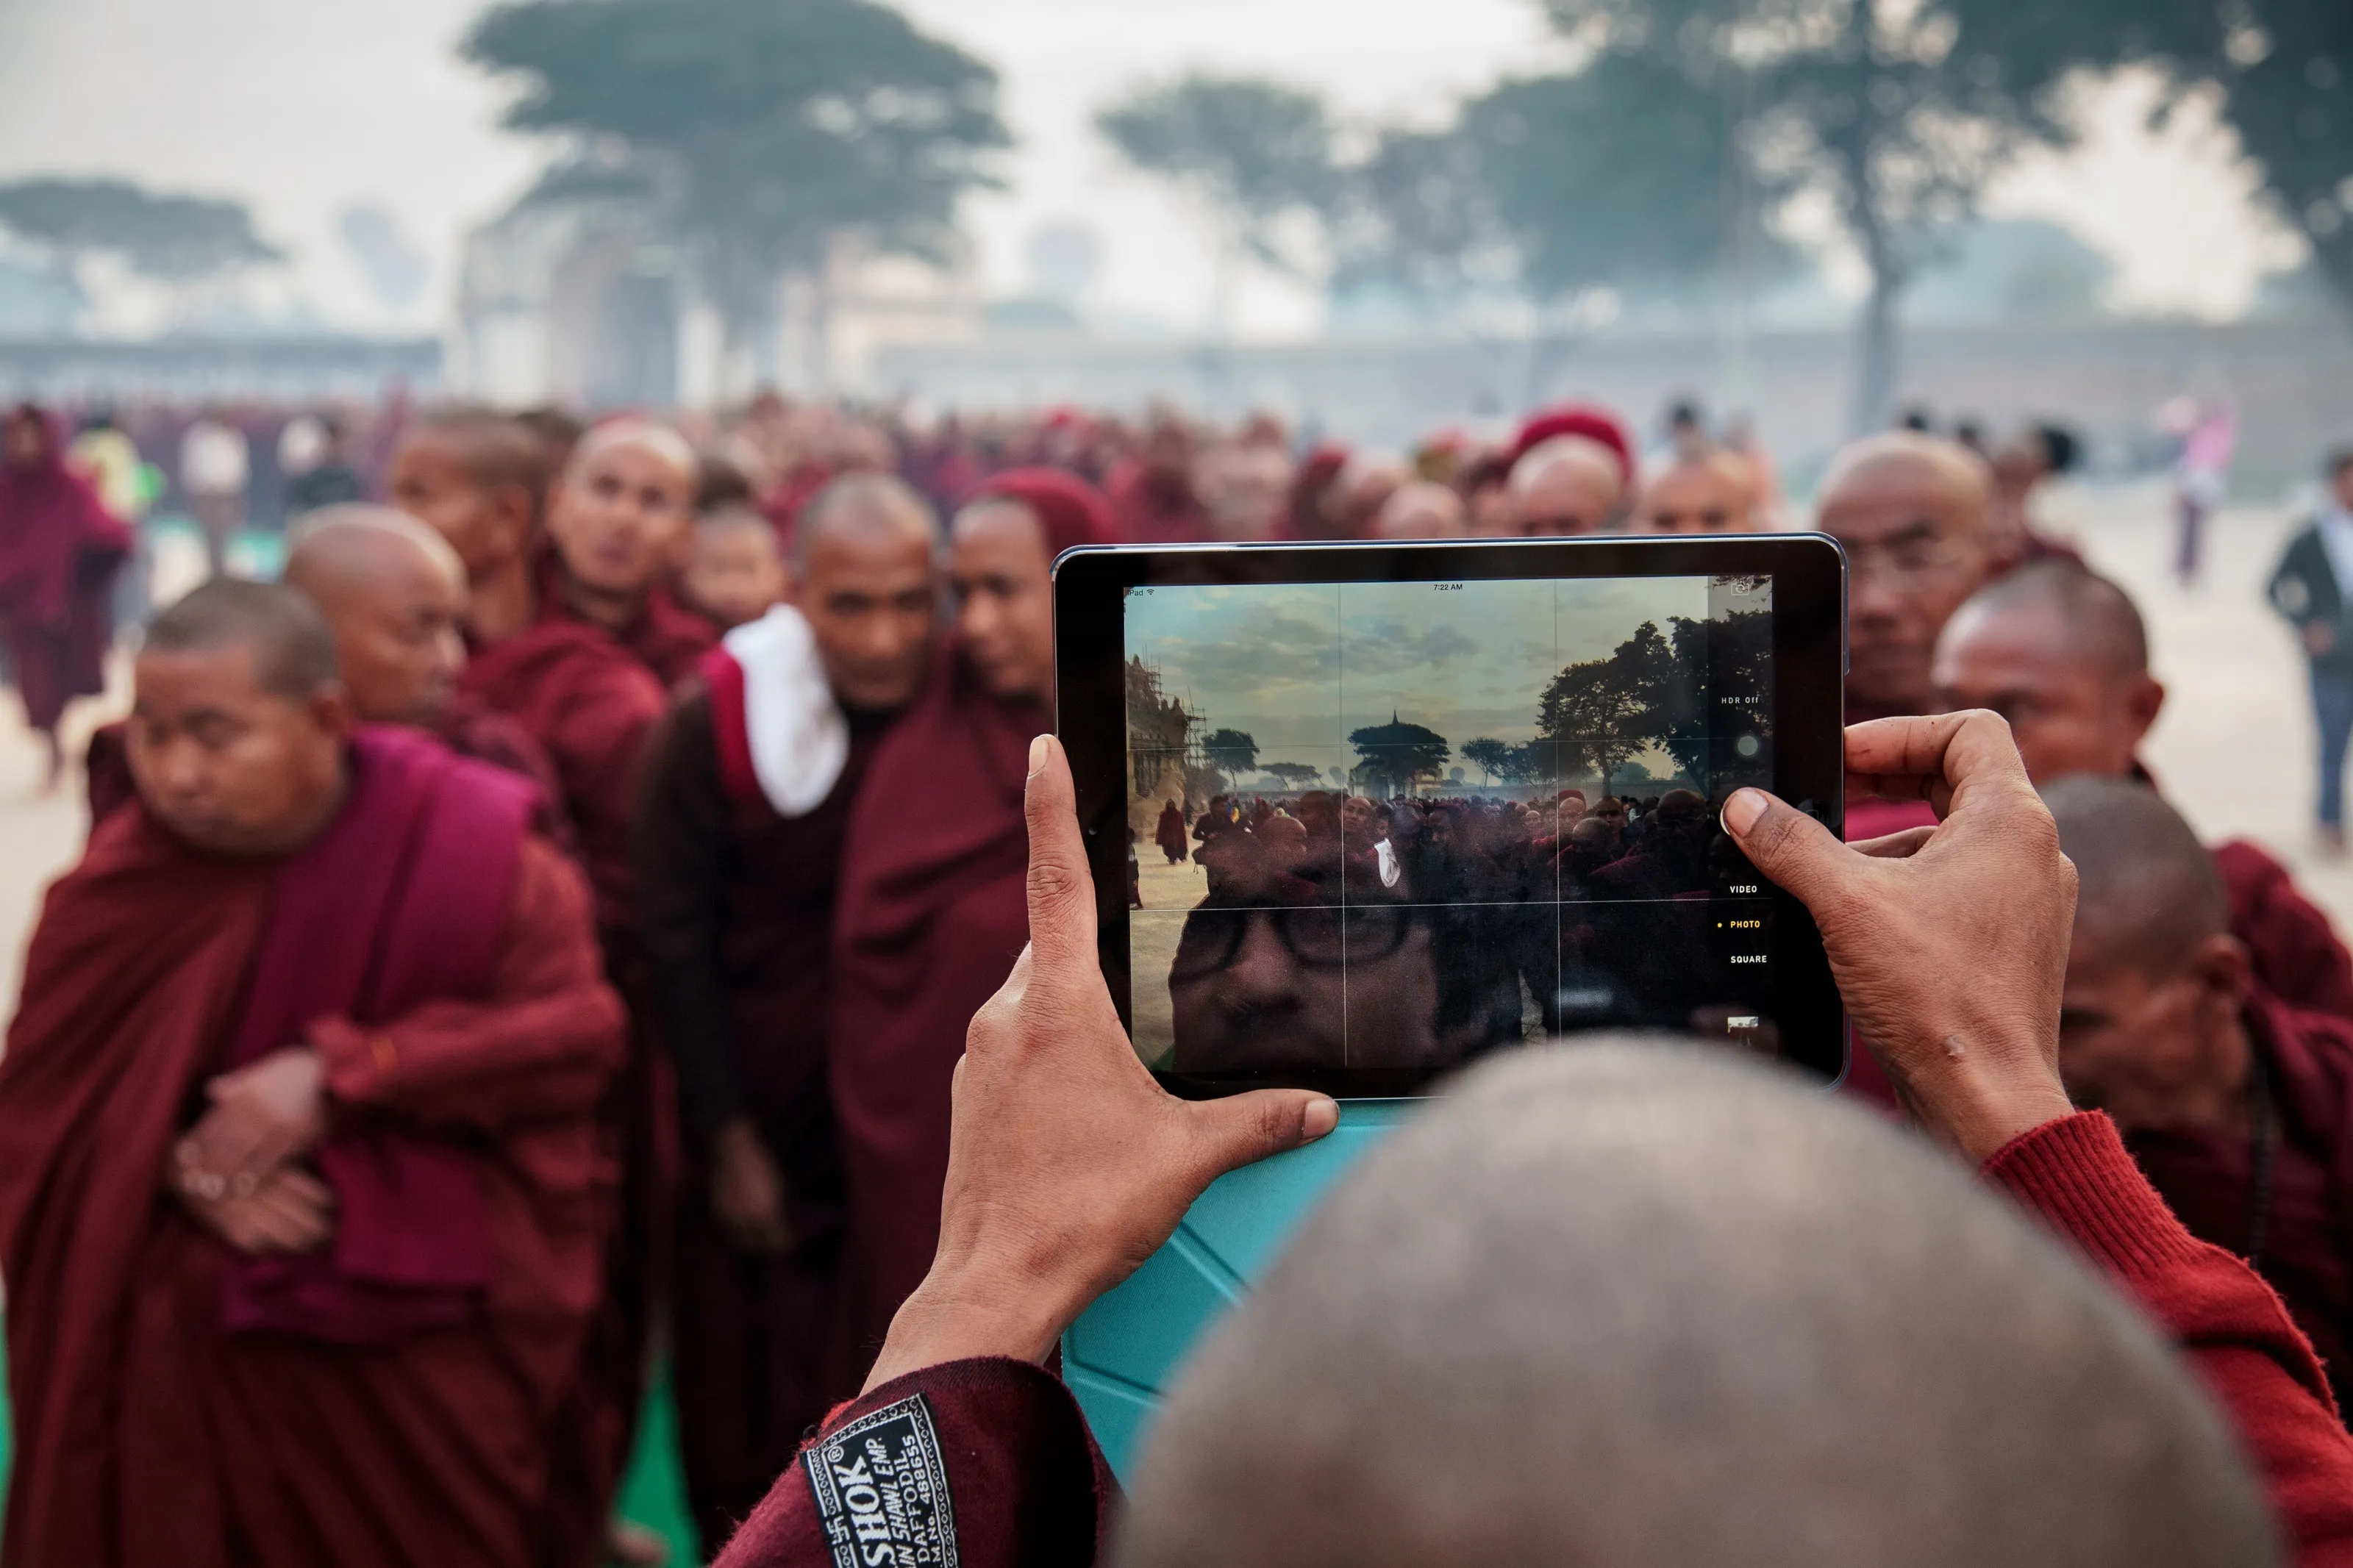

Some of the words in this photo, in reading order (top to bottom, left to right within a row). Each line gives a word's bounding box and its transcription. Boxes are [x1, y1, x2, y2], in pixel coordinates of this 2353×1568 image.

[1729, 885, 1757, 893] VIDEO
[1730, 955, 1767, 964] SQUARE
[865, 1436, 894, 1476] EMP.
[833, 1455, 897, 1568] SHOK
[880, 1481, 911, 1542] SHAWL
[894, 1450, 930, 1563] DAFFODIL
[896, 1544, 917, 1568] IN
